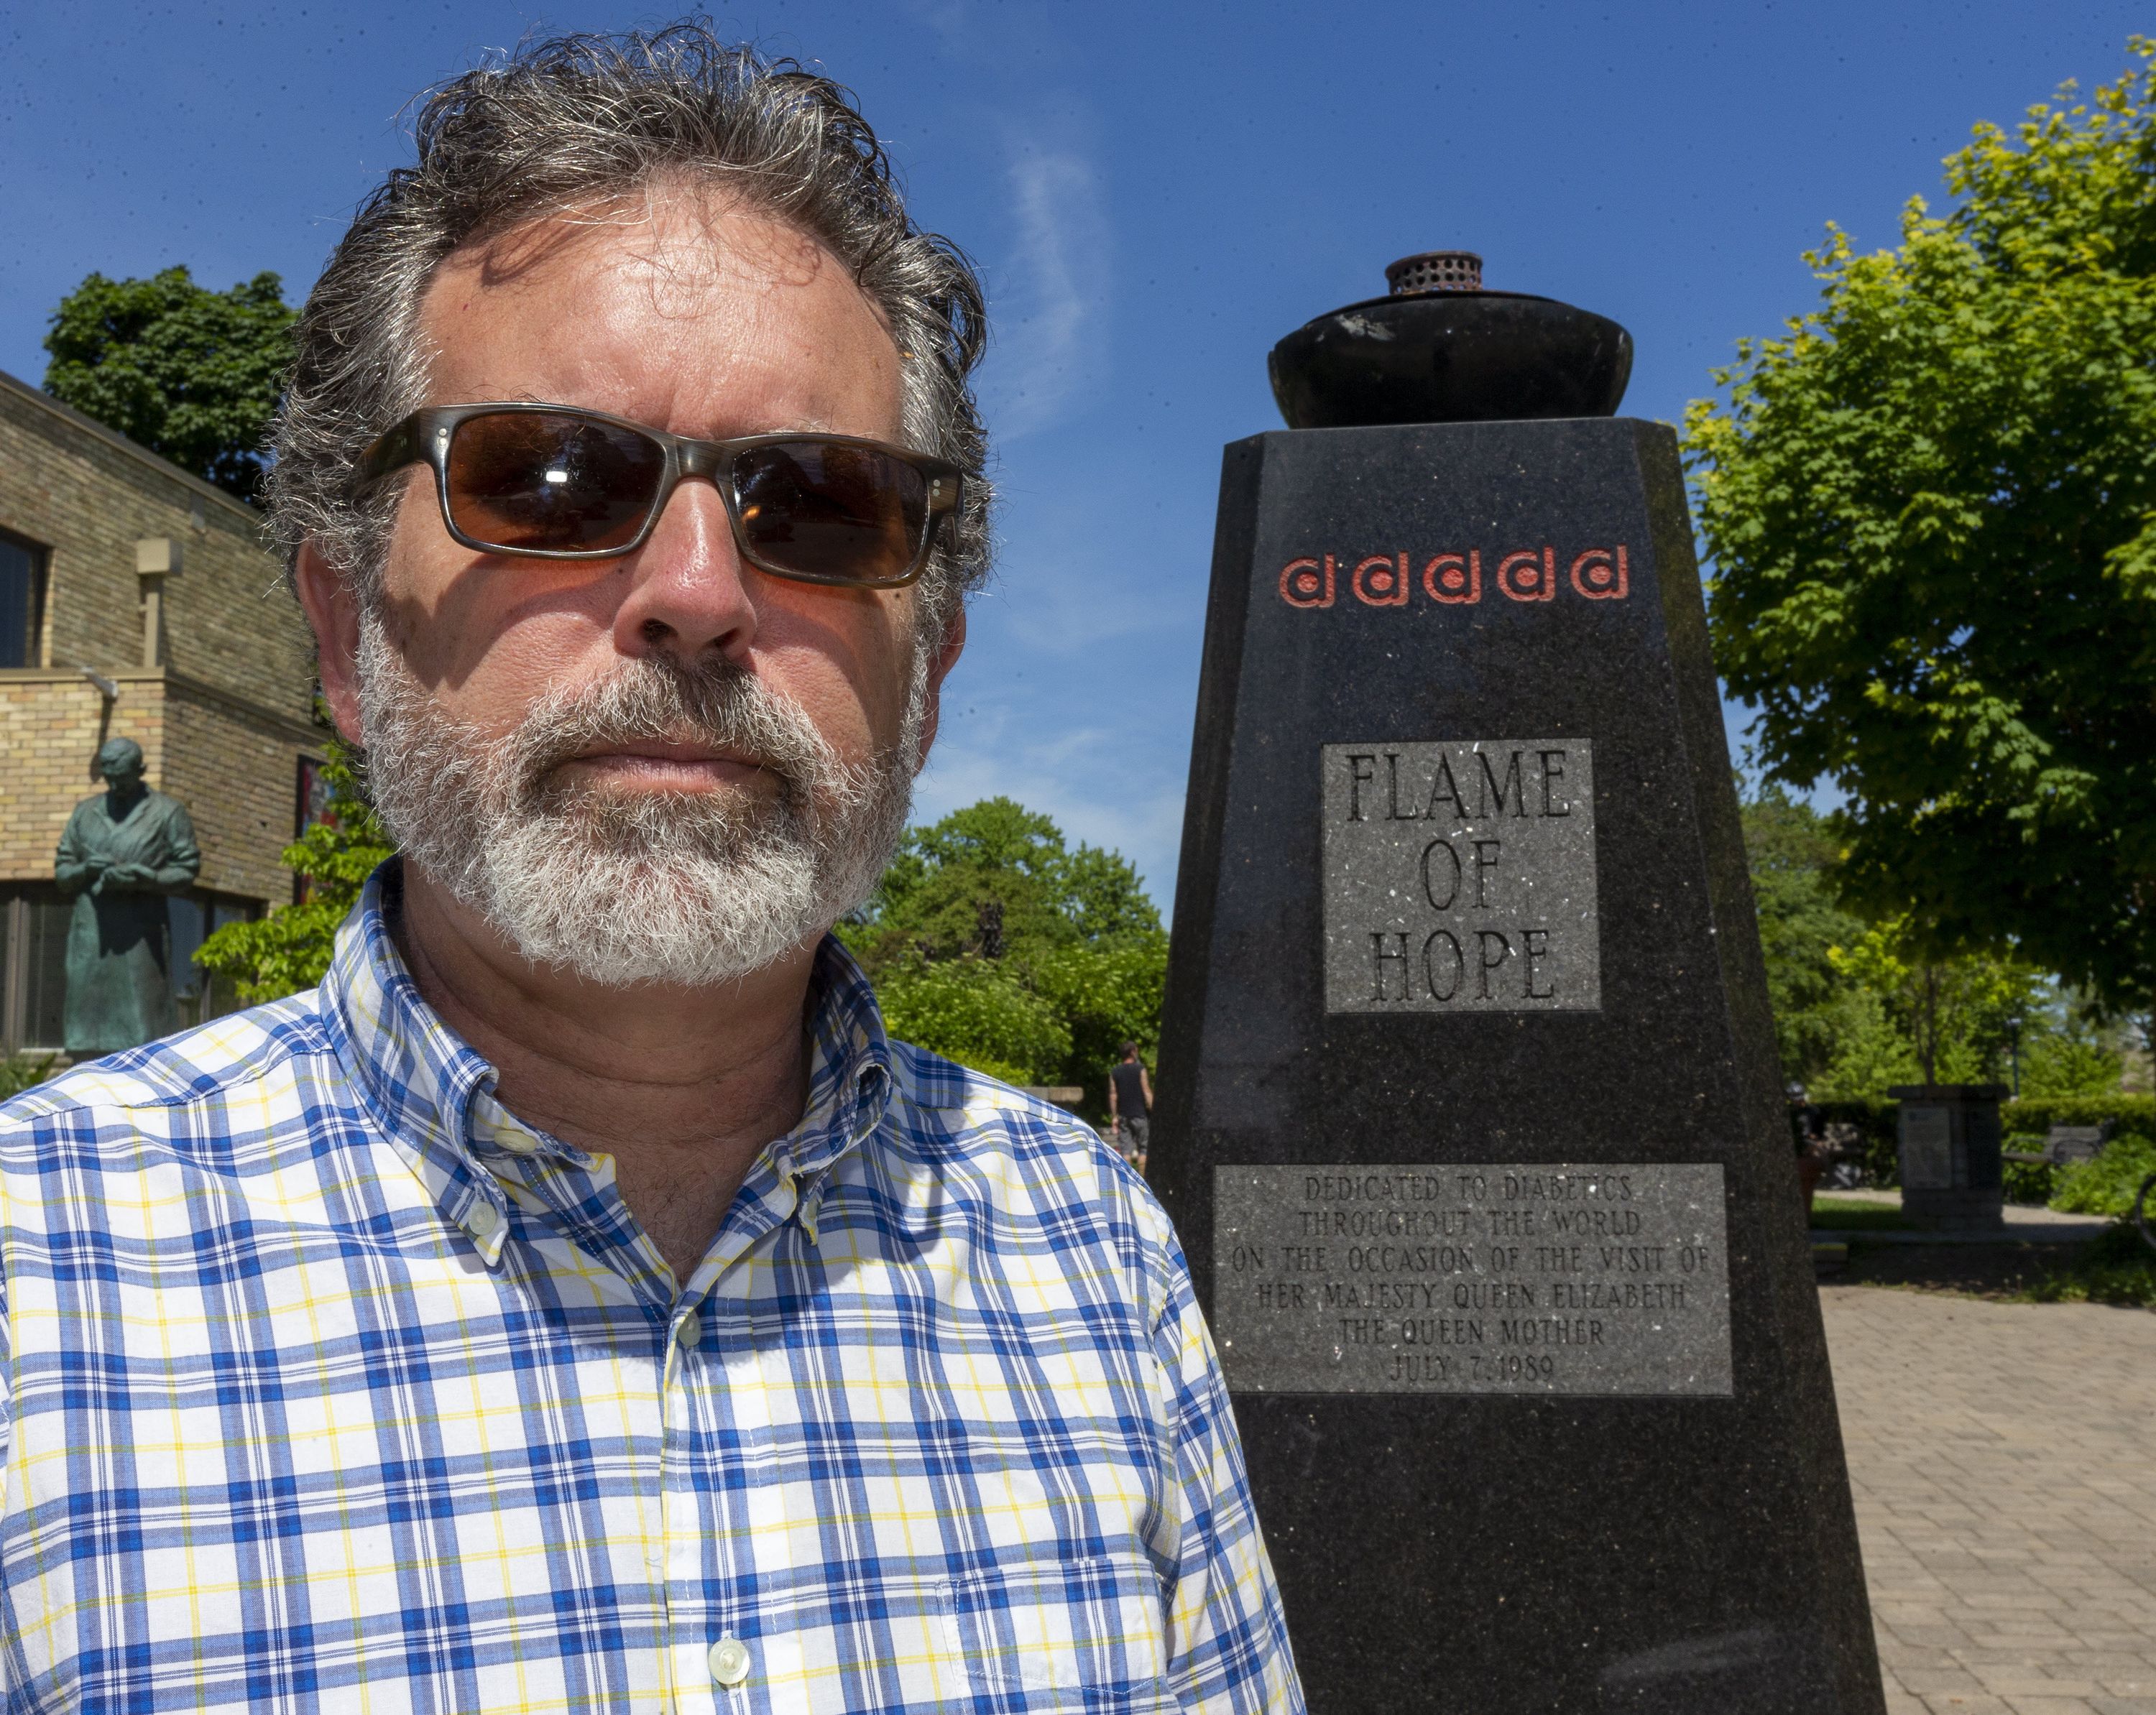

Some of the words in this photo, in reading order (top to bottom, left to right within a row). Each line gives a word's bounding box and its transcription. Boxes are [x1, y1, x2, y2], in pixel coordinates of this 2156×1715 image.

[1346, 749, 1570, 821] FLAME
[1420, 838, 1500, 910] OF
[1370, 928, 1554, 1002] HOPE
[1306, 1176, 1439, 1201] DEDICATED
[1458, 1175, 1487, 1201] TO
[1504, 1175, 1632, 1201] DIABETICS
[1298, 1211, 1470, 1236] THROUGHOUT
[1487, 1211, 1534, 1236] THE
[1552, 1211, 1641, 1236] WORLD
[1232, 1247, 1264, 1272] ON
[1281, 1247, 1327, 1272] THE
[1349, 1247, 1473, 1272] OCCASION
[1491, 1247, 1519, 1272] OF
[1536, 1247, 1583, 1272] THE
[1600, 1247, 1664, 1272] VISIT
[1681, 1247, 1710, 1272] OF
[1257, 1284, 1306, 1308] HER
[1324, 1283, 1437, 1309] MAJESTY
[1453, 1283, 1535, 1310] QUEEN
[1553, 1283, 1686, 1309] ELIZABETH
[1339, 1319, 1386, 1345] THE
[1401, 1319, 1483, 1345] QUEEN
[1500, 1319, 1604, 1345] MOTHER
[1390, 1354, 1452, 1382] JULY
